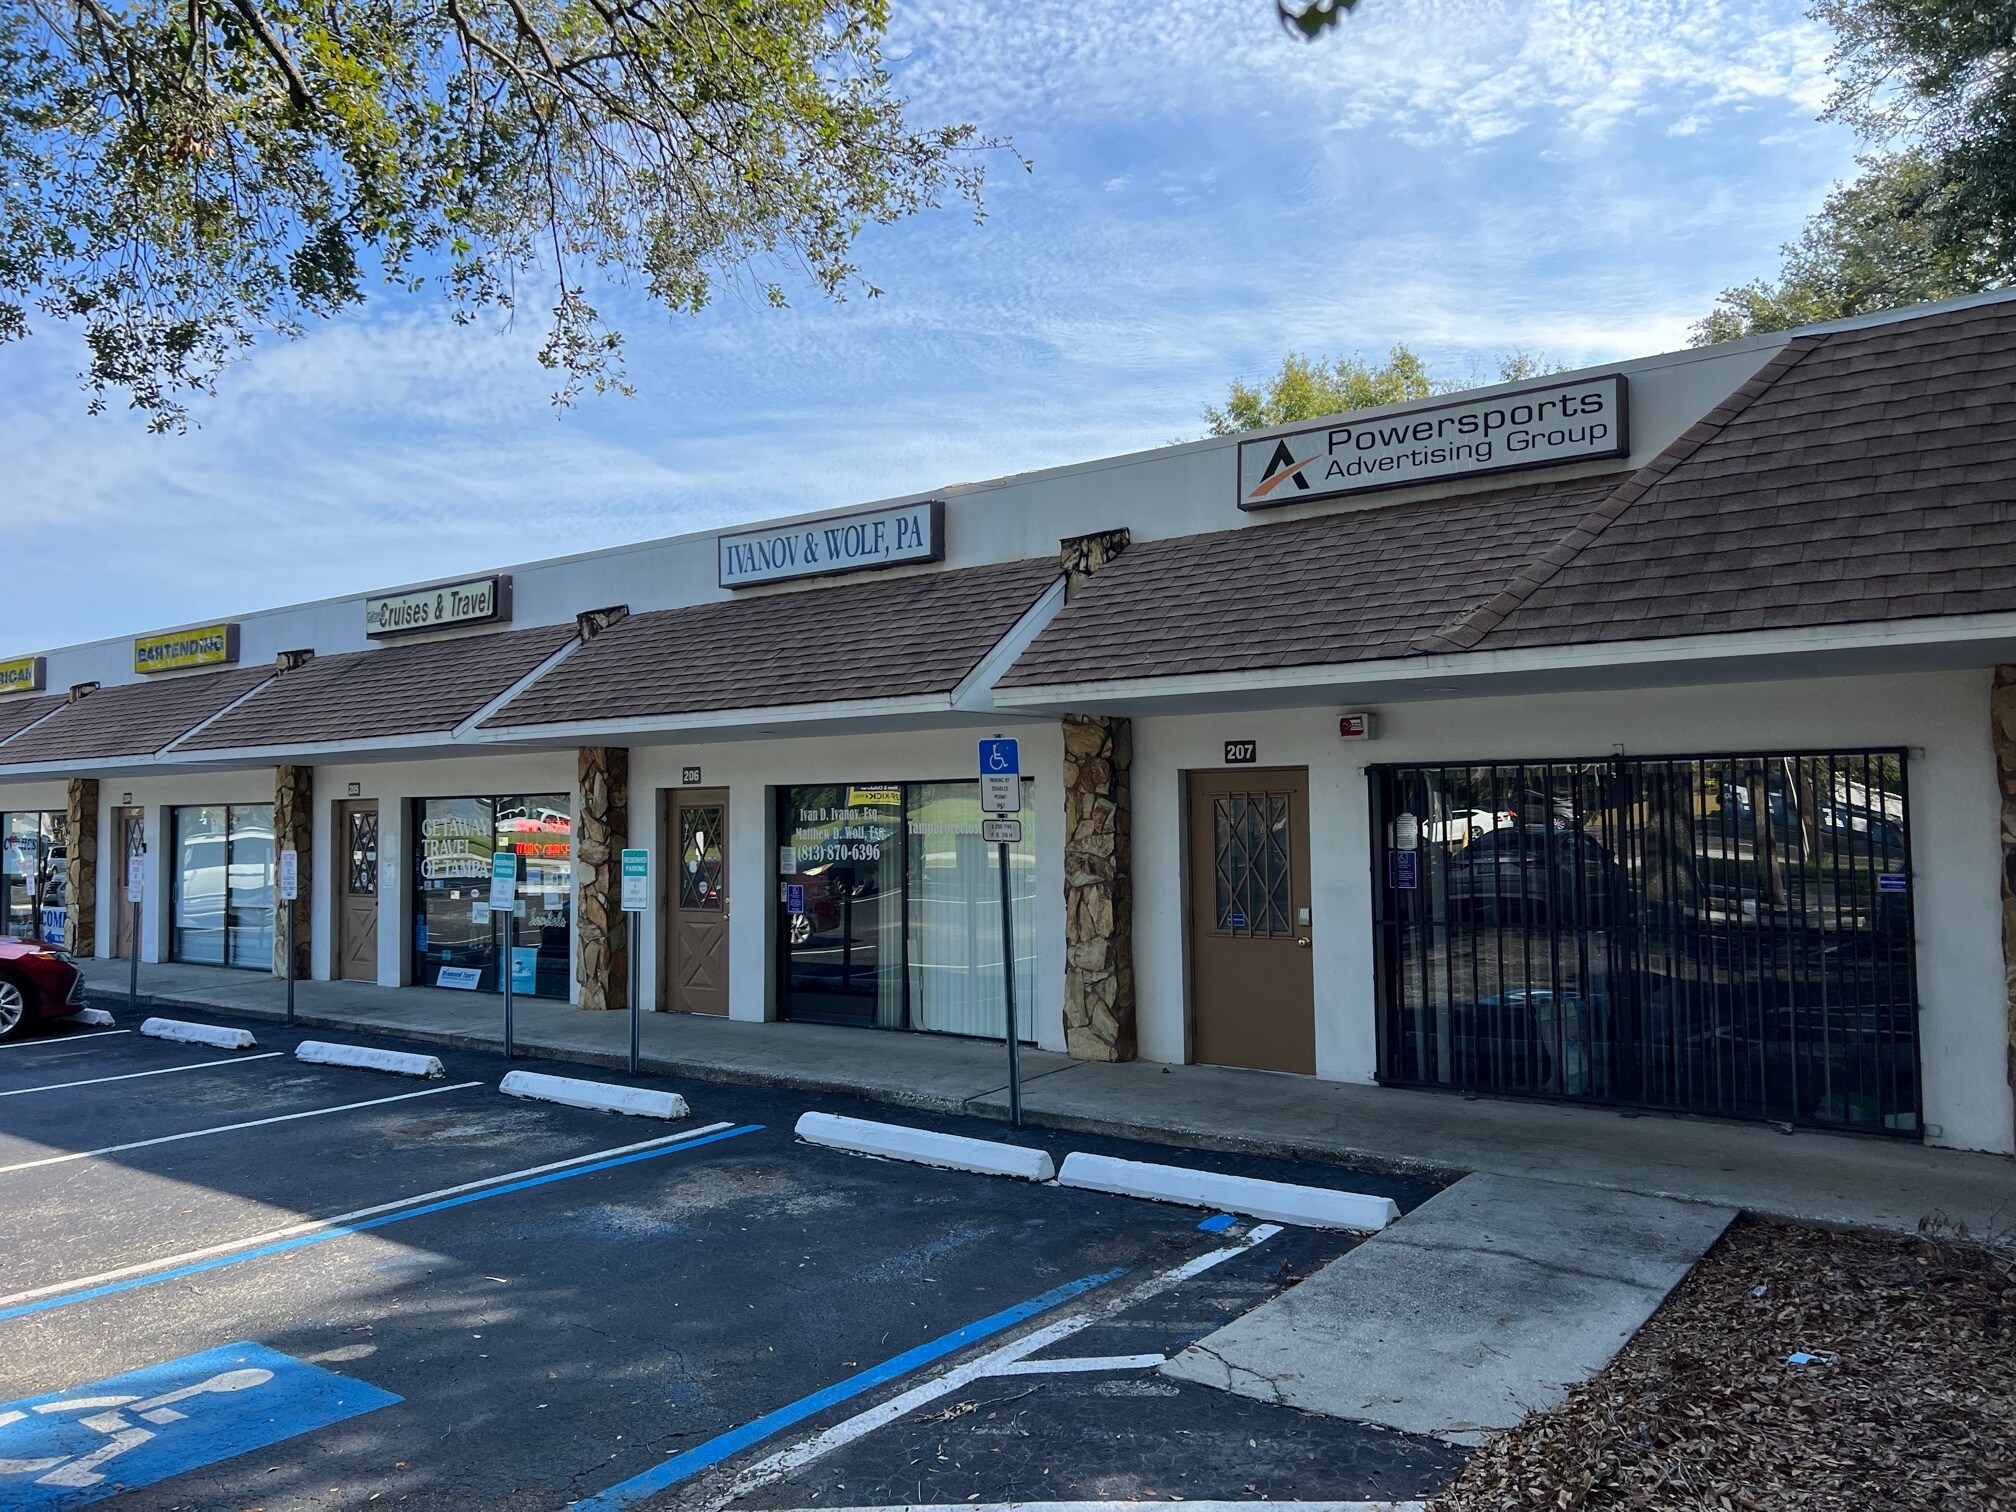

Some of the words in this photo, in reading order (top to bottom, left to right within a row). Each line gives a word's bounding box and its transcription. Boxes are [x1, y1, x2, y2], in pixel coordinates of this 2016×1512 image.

[1328, 393, 1604, 456] Powersports
[1325, 441, 1493, 480] Advertising
[1507, 422, 1608, 453] Group
[727, 535, 799, 576] IVANOV
[803, 532, 819, 564] &
[824, 521, 889, 558] WOLF,
[896, 515, 923, 550] PA
[379, 600, 429, 628] Cruises
[434, 593, 443, 620] &
[451, 585, 492, 617] Travel
[137, 634, 225, 663] BARTENDING
[1227, 744, 1254, 760] 207
[684, 770, 700, 782] 206
[800, 808, 818, 822] Ivan
[820, 808, 828, 821] D.
[831, 807, 861, 821] Ivanov,
[864, 806, 880, 822] Esq.
[421, 817, 492, 837] GETAWAY
[795, 827, 830, 841] Matthew
[833, 827, 842, 840] D.
[845, 826, 867, 840] Wolf,
[421, 839, 473, 857] TRAVEL
[797, 844, 825, 862] (813)
[827, 843, 880, 861] 870-6396
[421, 859, 439, 878] OF
[443, 859, 489, 878] TAMPA
[624, 856, 647, 864] RESERVED
[528, 908, 567, 928] Sandals
